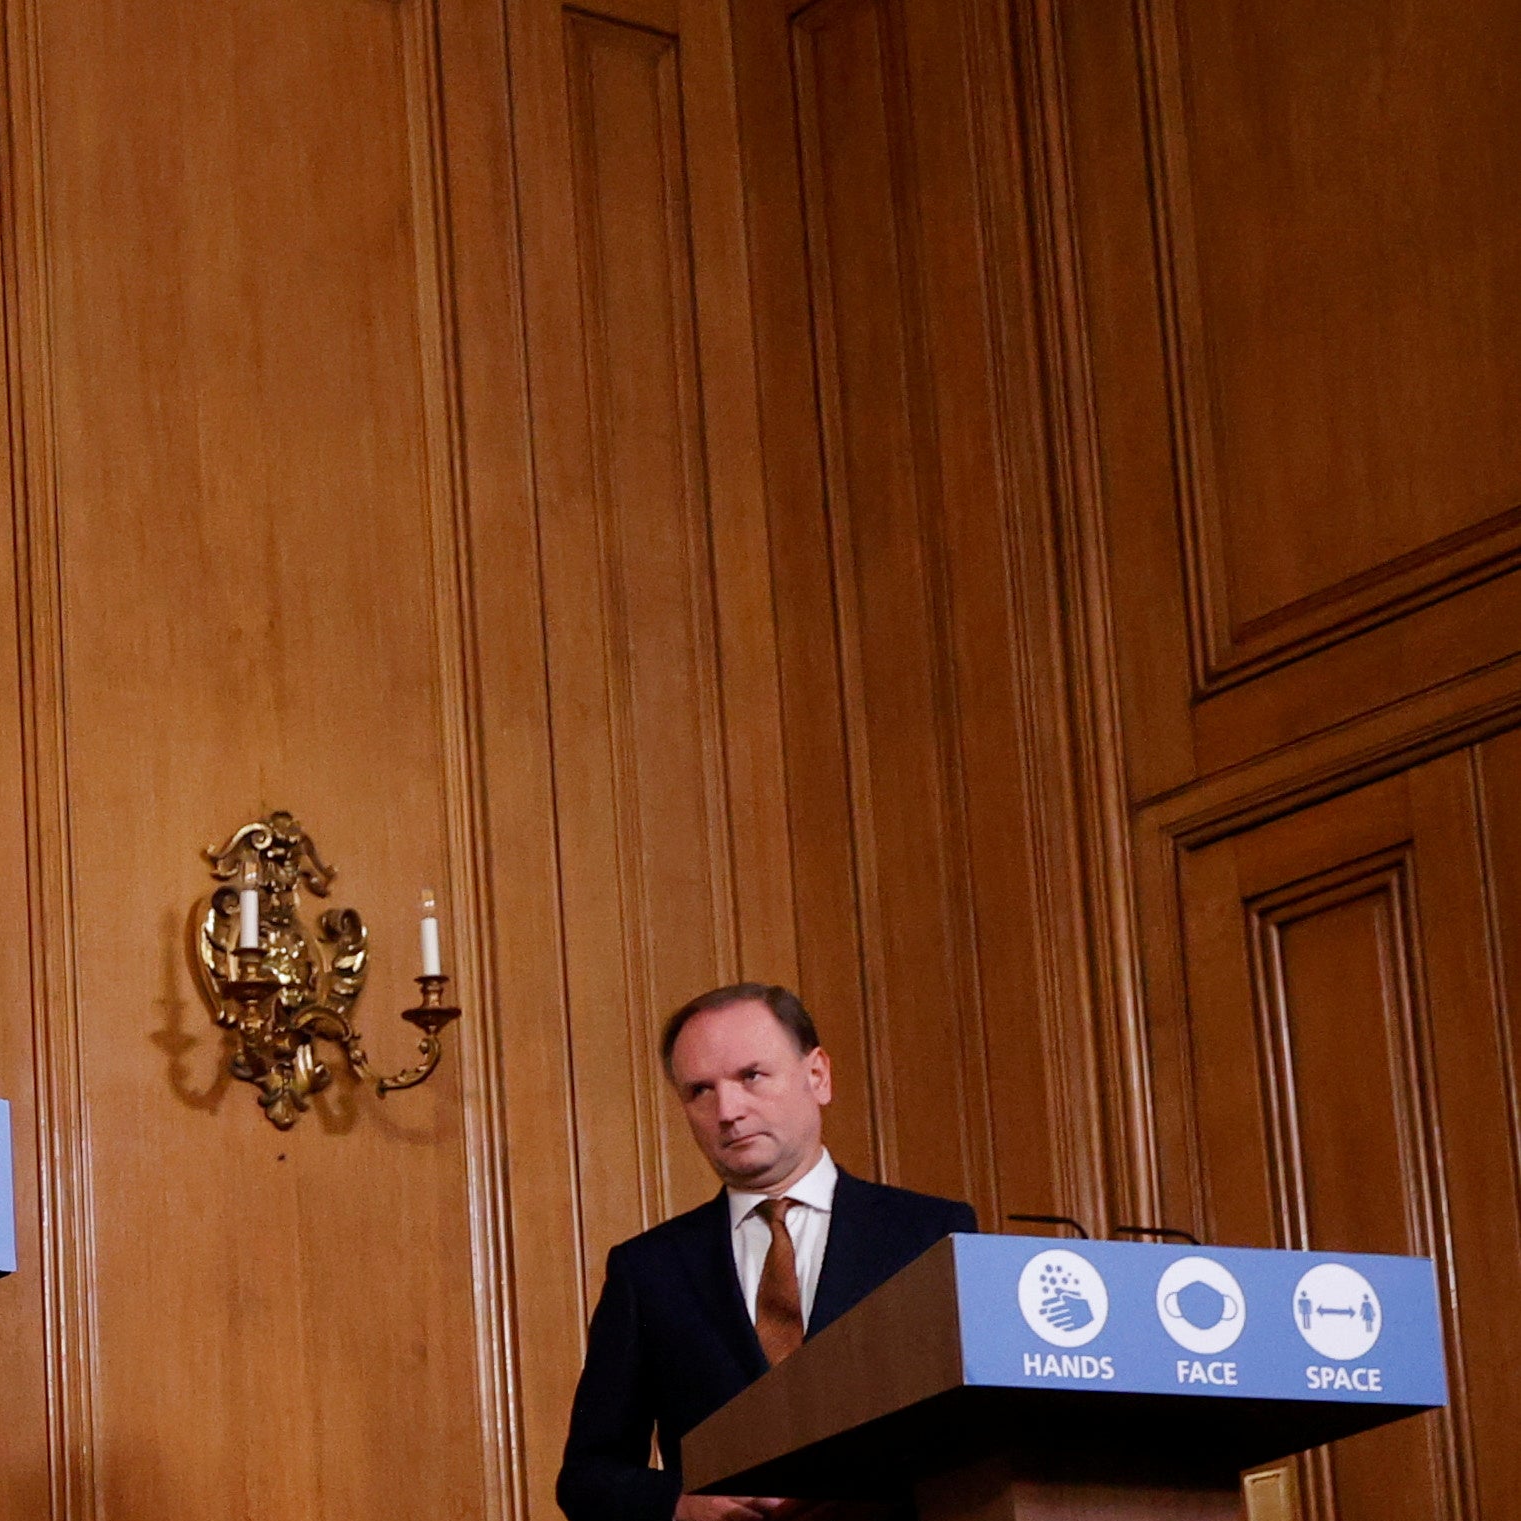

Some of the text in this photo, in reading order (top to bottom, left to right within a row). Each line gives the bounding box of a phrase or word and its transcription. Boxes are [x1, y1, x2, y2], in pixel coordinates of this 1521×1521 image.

[1023, 1352, 1383, 1392] HANDS FACE SPACE
